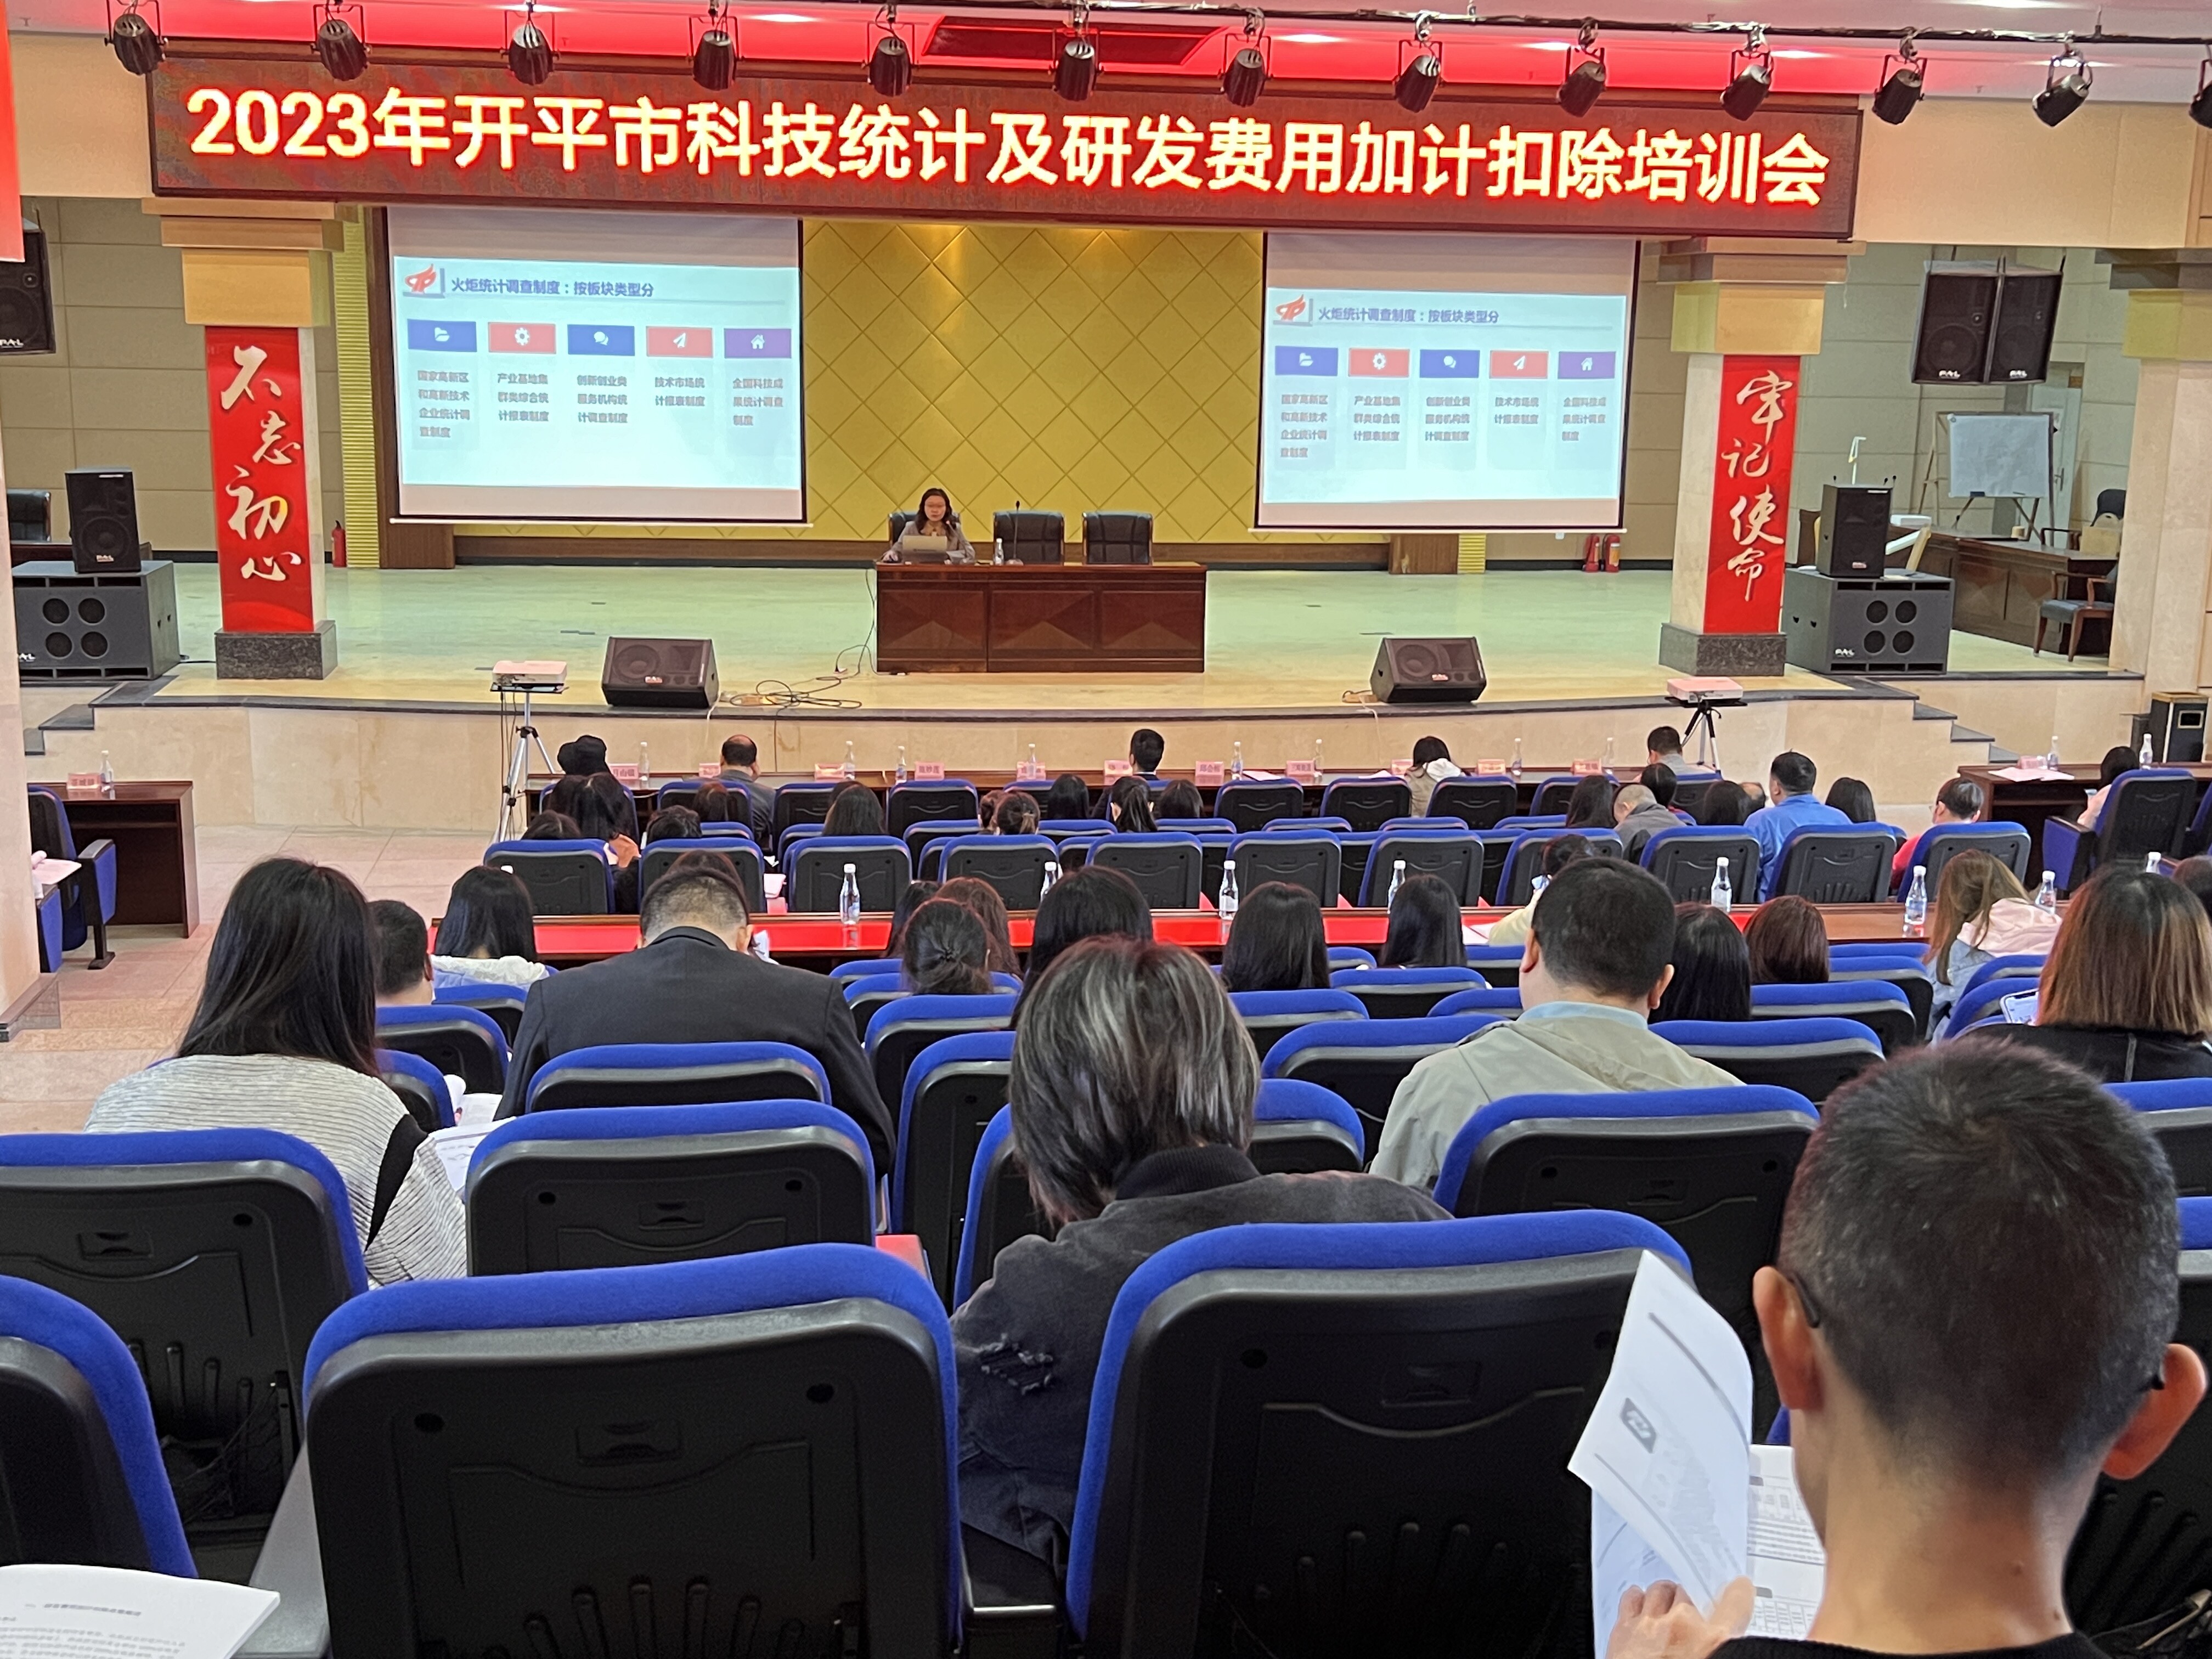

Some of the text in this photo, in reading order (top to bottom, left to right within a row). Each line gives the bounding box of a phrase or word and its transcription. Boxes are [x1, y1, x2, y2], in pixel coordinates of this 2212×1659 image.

[187, 87, 1830, 207] 2023年开平市科技统计及研发费用加计扣除培训会
[221, 345, 302, 582] 不忘初心
[1721, 370, 1793, 602] 牢记使命
